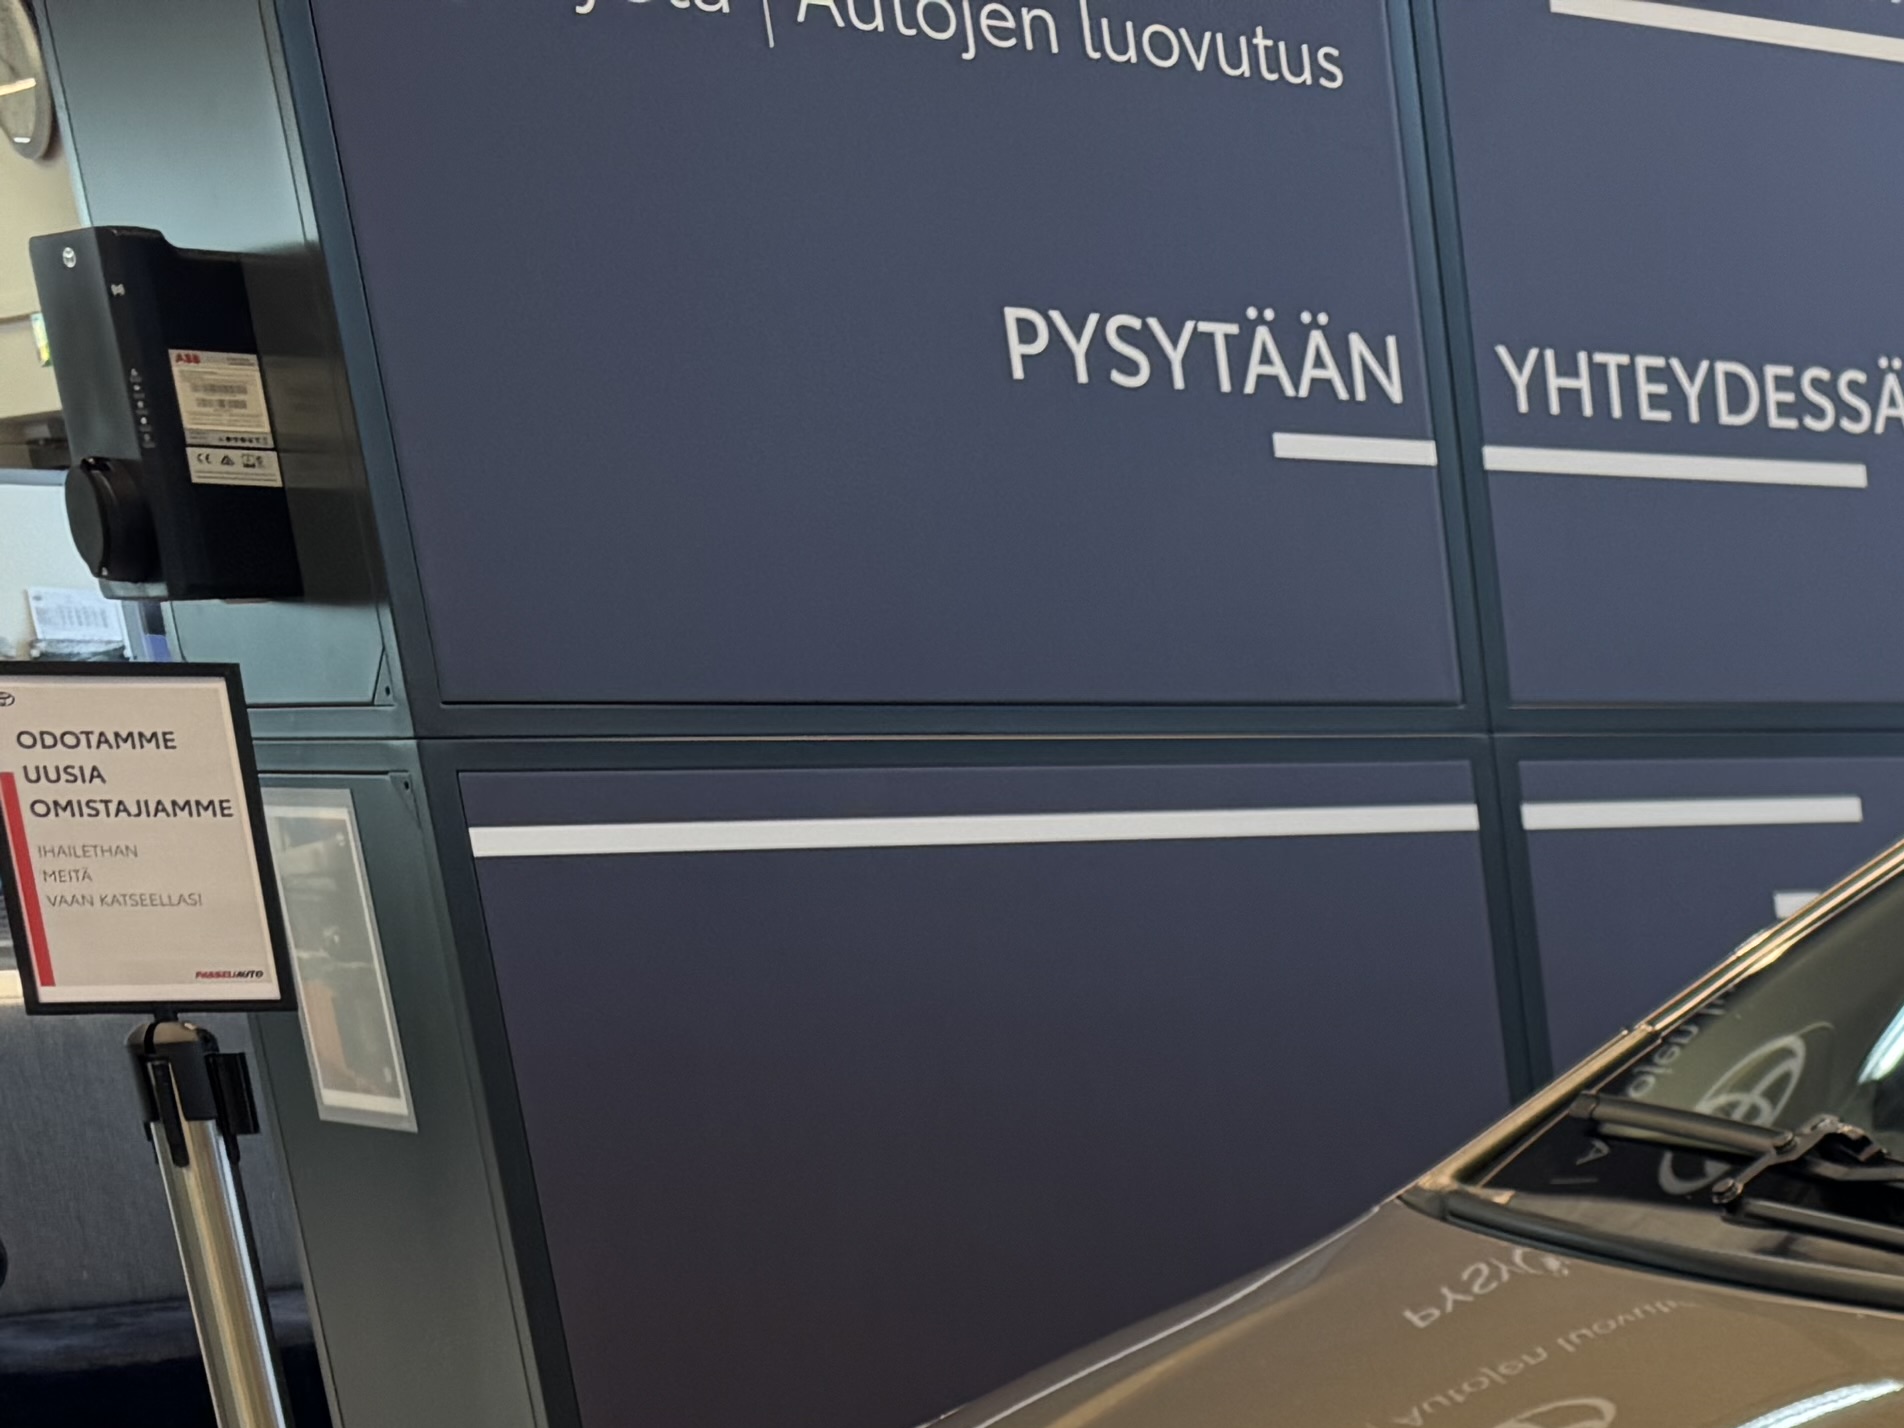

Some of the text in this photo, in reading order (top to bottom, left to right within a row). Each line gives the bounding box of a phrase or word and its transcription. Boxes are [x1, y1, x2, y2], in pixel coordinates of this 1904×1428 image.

[1083, 0, 1344, 88] luovutus
[1003, 305, 1403, 405] PYSYTÄÄN
[16, 730, 177, 750] ODOTAMME
[23, 764, 107, 785] UUSIA
[30, 798, 234, 819] OMISTAJIAMME
[37, 844, 139, 860] IHAILETHAN
[43, 866, 93, 883] MEITÄ
[47, 893, 96, 908] VAAN
